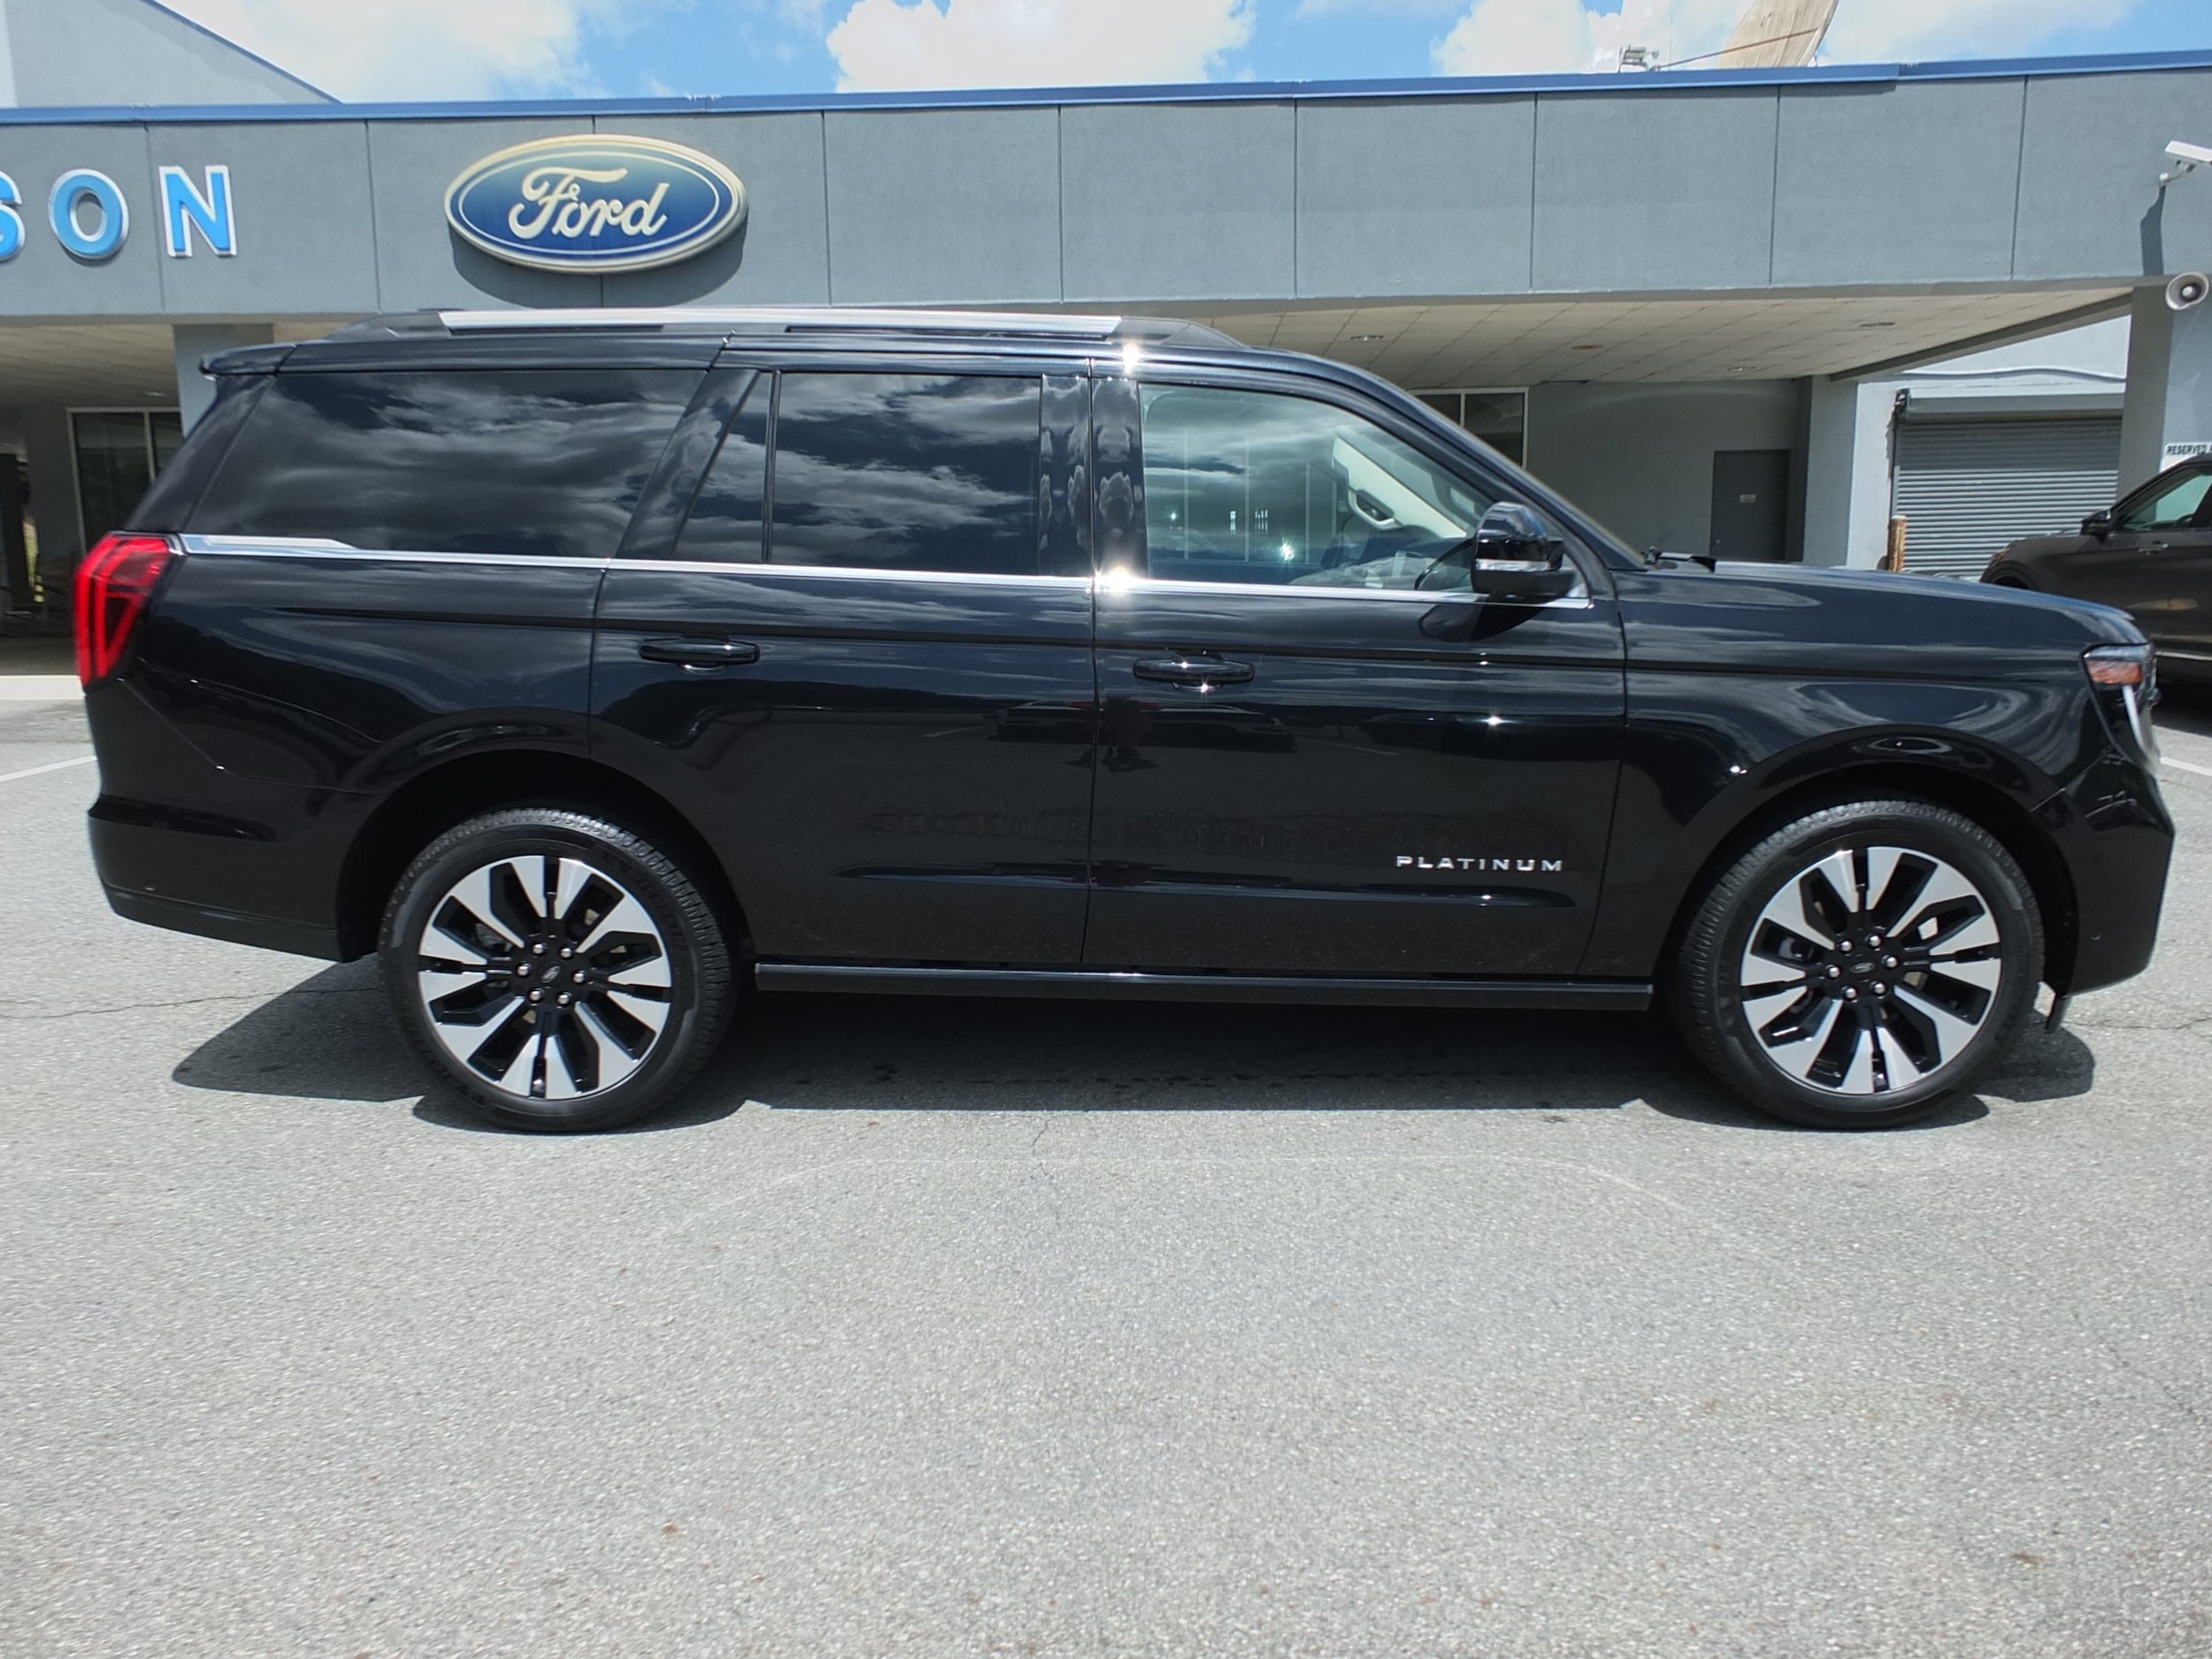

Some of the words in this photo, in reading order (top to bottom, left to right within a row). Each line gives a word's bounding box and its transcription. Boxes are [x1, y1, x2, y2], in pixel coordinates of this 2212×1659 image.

[508, 166, 670, 240] Ford
[2166, 445, 2208, 455] RESERVED
[1396, 856, 1563, 872] PLATINUM
